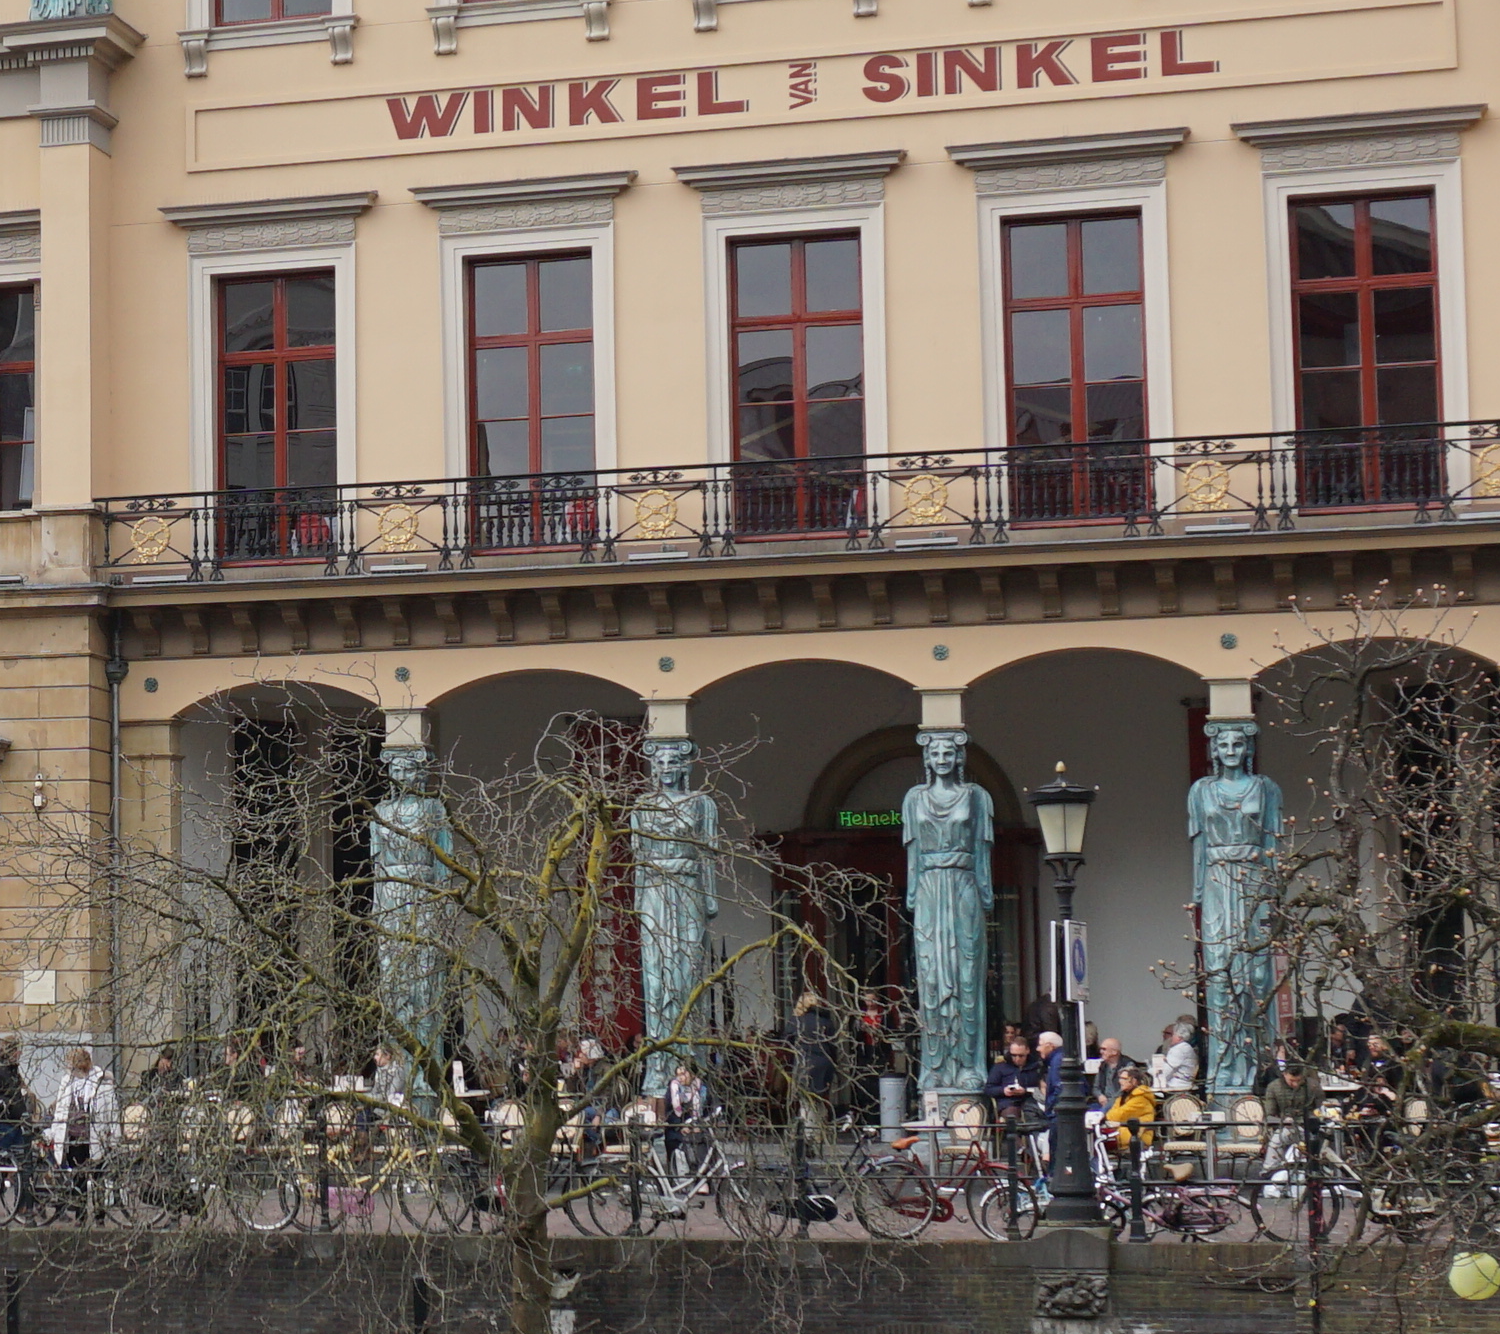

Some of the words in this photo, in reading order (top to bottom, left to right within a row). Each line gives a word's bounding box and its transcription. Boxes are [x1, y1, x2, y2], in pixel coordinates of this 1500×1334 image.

[386, 69, 750, 141] WINKEL
[788, 61, 817, 110] VAN
[861, 29, 1221, 105] SINKEL
[839, 810, 902, 827] Heinek
